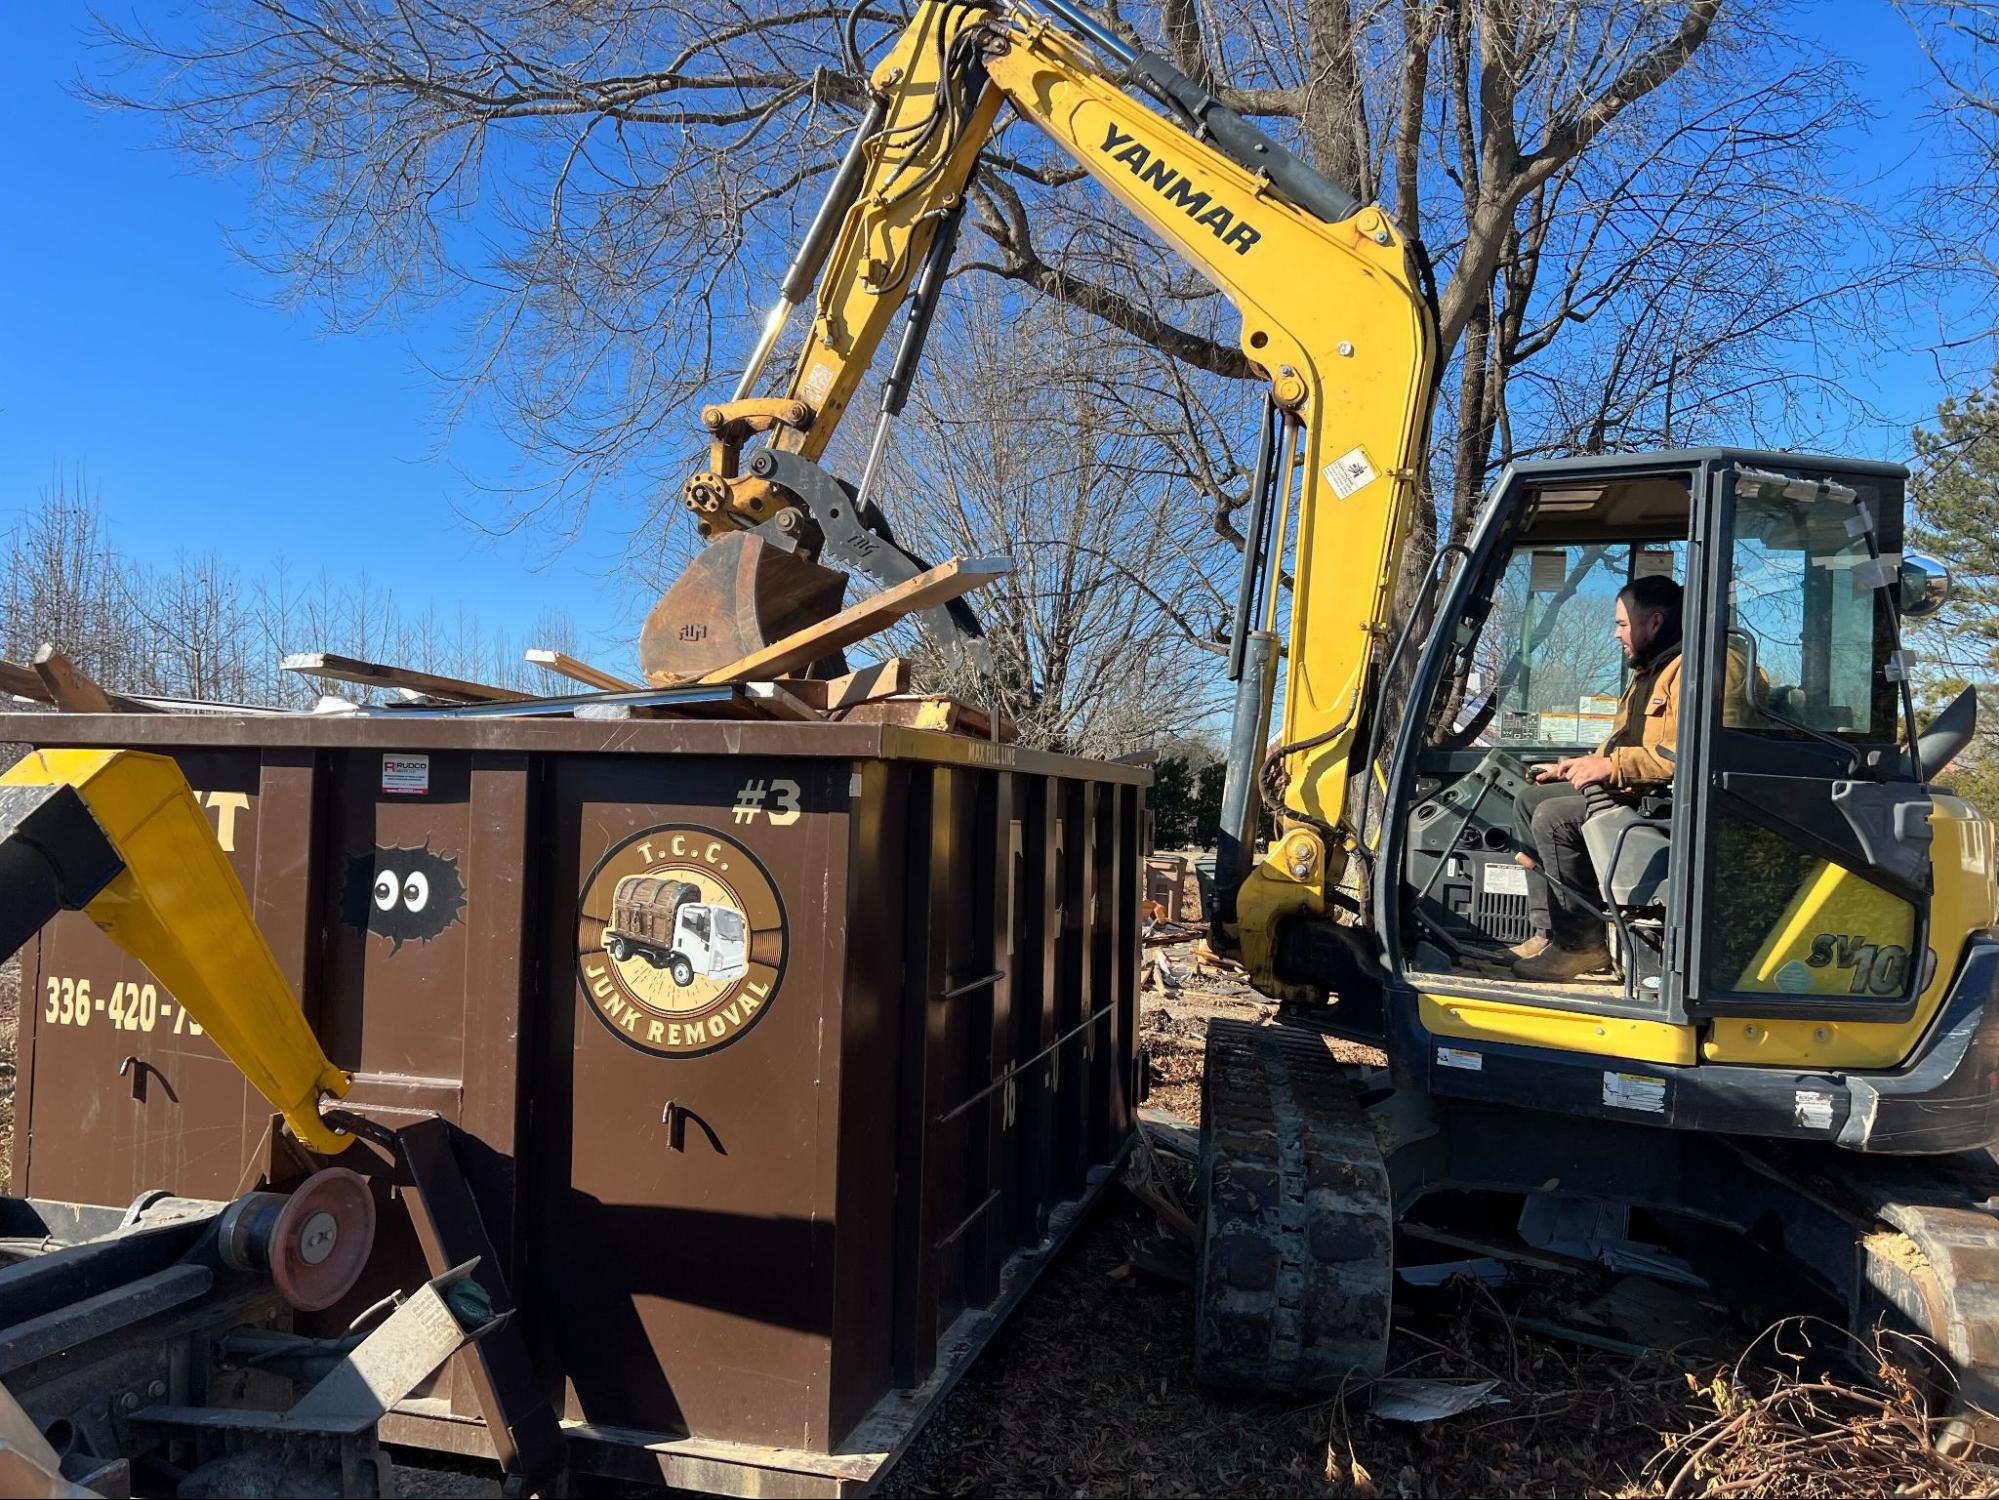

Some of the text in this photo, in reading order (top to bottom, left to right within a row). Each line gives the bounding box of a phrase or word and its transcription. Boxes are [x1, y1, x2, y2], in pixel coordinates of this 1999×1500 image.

[1100, 121, 1262, 256] YANMAR
[968, 741, 985, 763] MAX
[986, 744, 1000, 765] FILL
[731, 779, 801, 826] #3
[637, 835, 729, 871] T.C.C.
[45, 976, 204, 1036] 336-420-7
[585, 962, 770, 1046] JUNK REMOVAL
